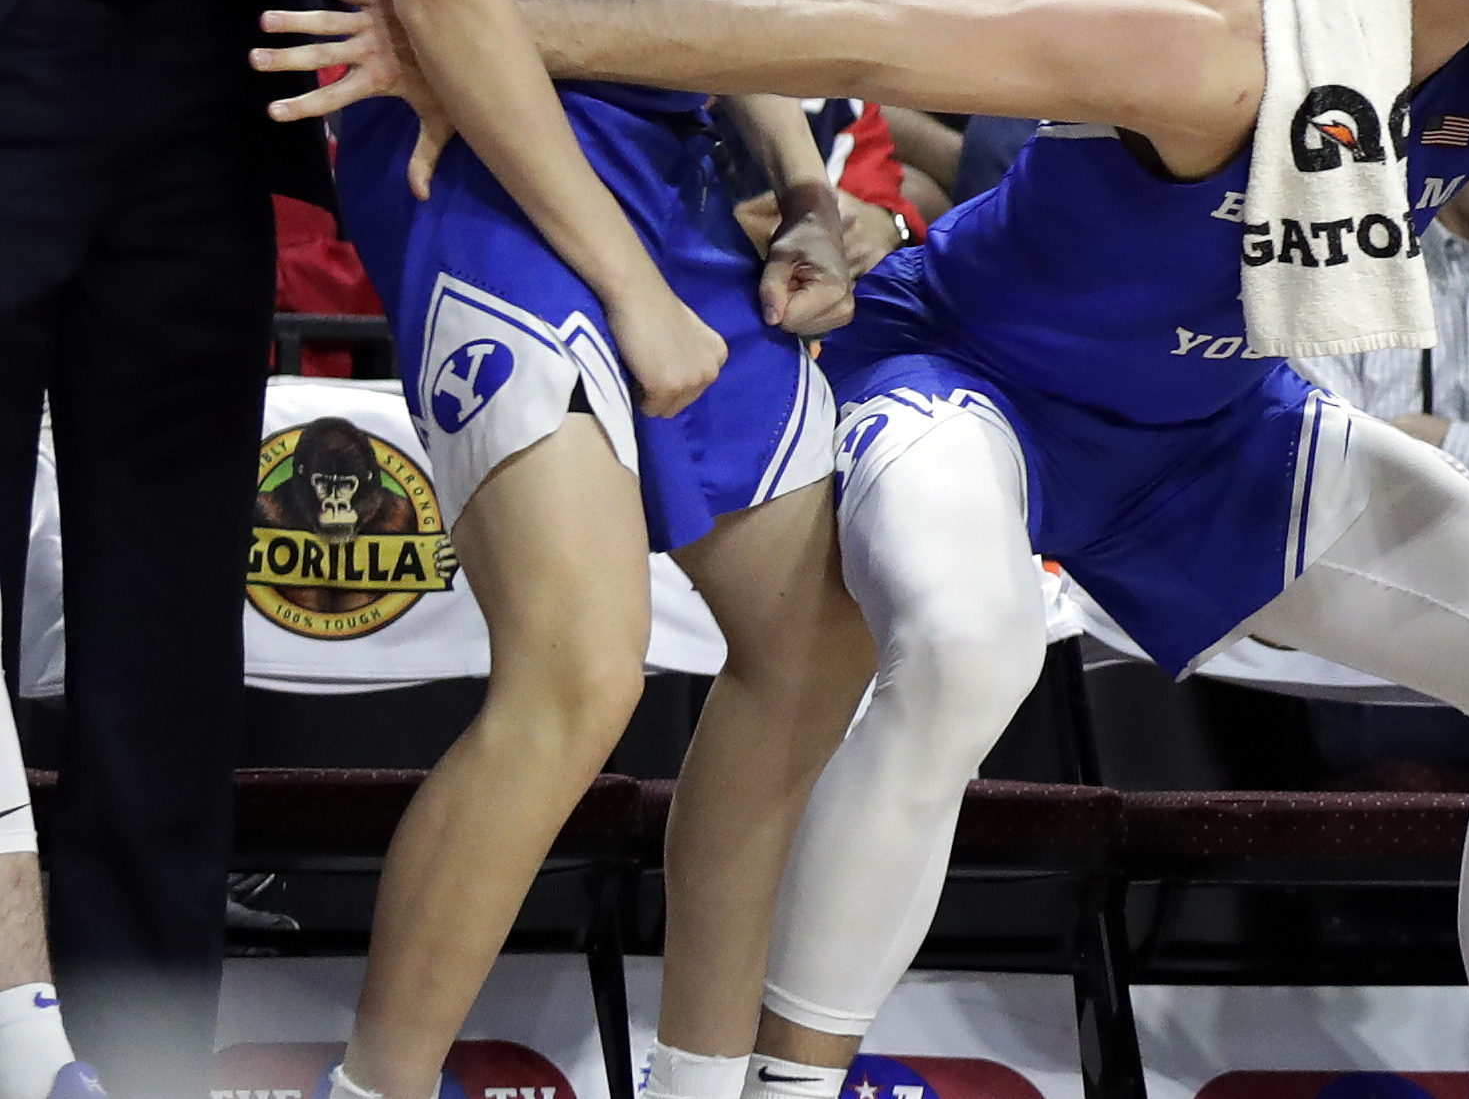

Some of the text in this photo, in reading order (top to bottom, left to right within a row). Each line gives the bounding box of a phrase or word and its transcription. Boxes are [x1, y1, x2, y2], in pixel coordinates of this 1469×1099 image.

[384, 454, 436, 527] STRONG
[275, 603, 382, 631] 100% TOUGH
